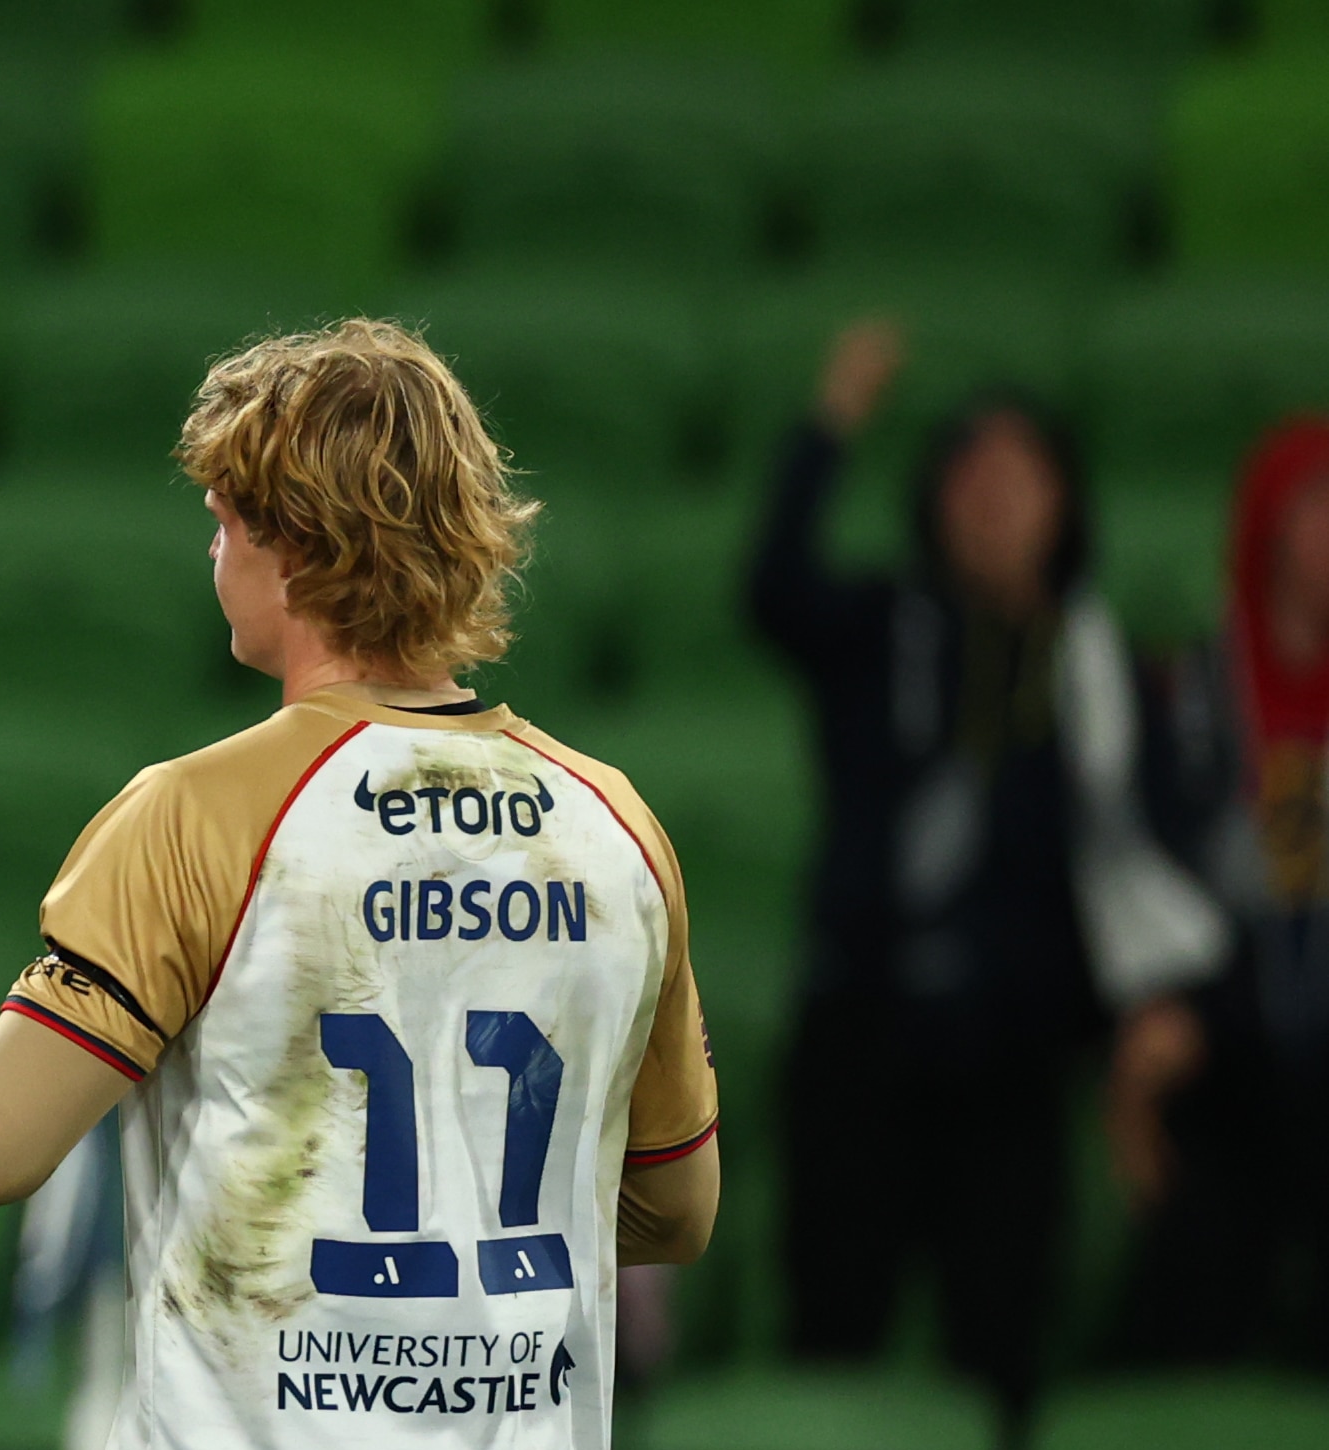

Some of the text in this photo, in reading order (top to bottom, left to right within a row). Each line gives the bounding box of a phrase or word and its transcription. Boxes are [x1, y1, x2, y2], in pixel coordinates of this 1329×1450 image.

[363, 879, 587, 942] GIBSON
[309, 1009, 575, 1299] 11
[278, 1329, 545, 1368] UNIVERSITY OF
[276, 1371, 541, 1414] NEWCASTLE
